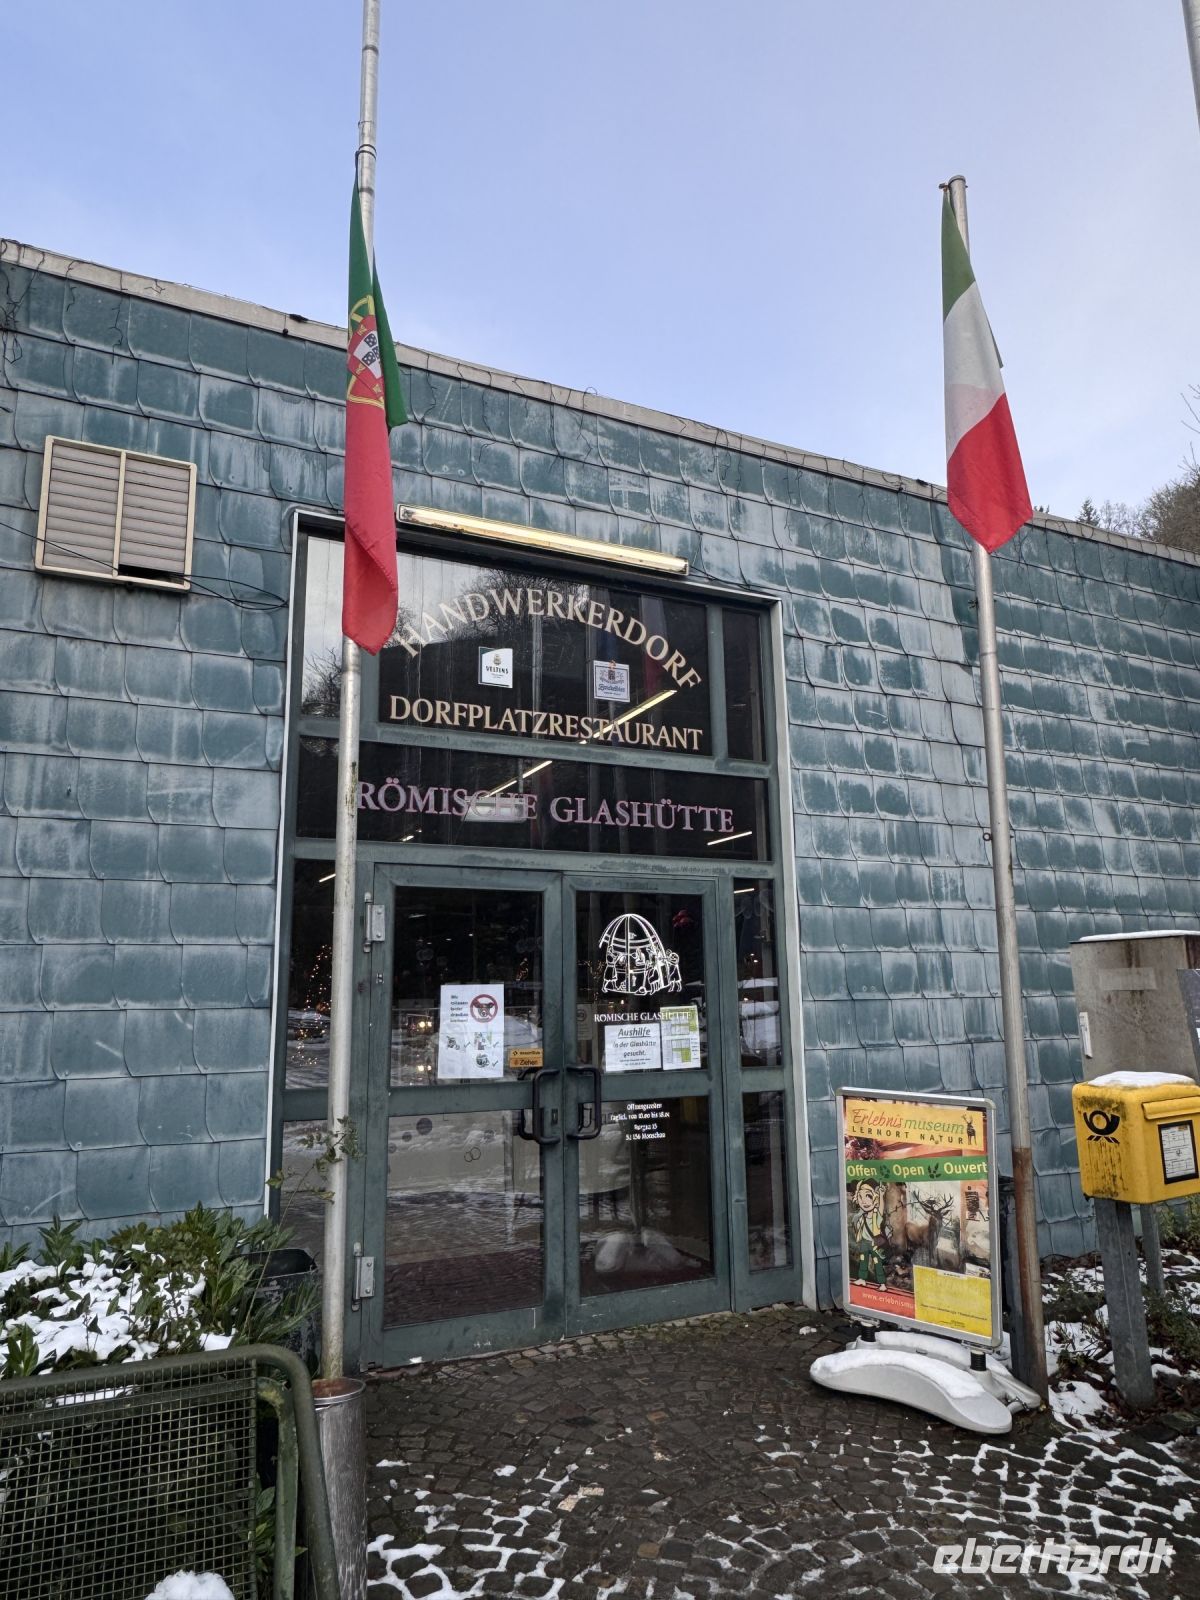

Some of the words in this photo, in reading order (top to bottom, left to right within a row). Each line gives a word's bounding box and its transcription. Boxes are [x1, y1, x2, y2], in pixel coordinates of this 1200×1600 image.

[398, 587, 702, 689] HANDWERKERDORF
[485, 665, 509, 675] VELTINS
[389, 694, 703, 750] DORFPLATZRESTAURANT
[357, 777, 538, 820] RÖMISCHE
[550, 797, 735, 833] GLASHÜTTE
[618, 1026, 651, 1037] Aushilfe
[852, 1126, 909, 1138] LERNORT
[920, 1133, 963, 1144] NATUR
[847, 1165, 877, 1177] Offen
[892, 1164, 925, 1178] Open
[944, 1161, 988, 1175] Ouvert
